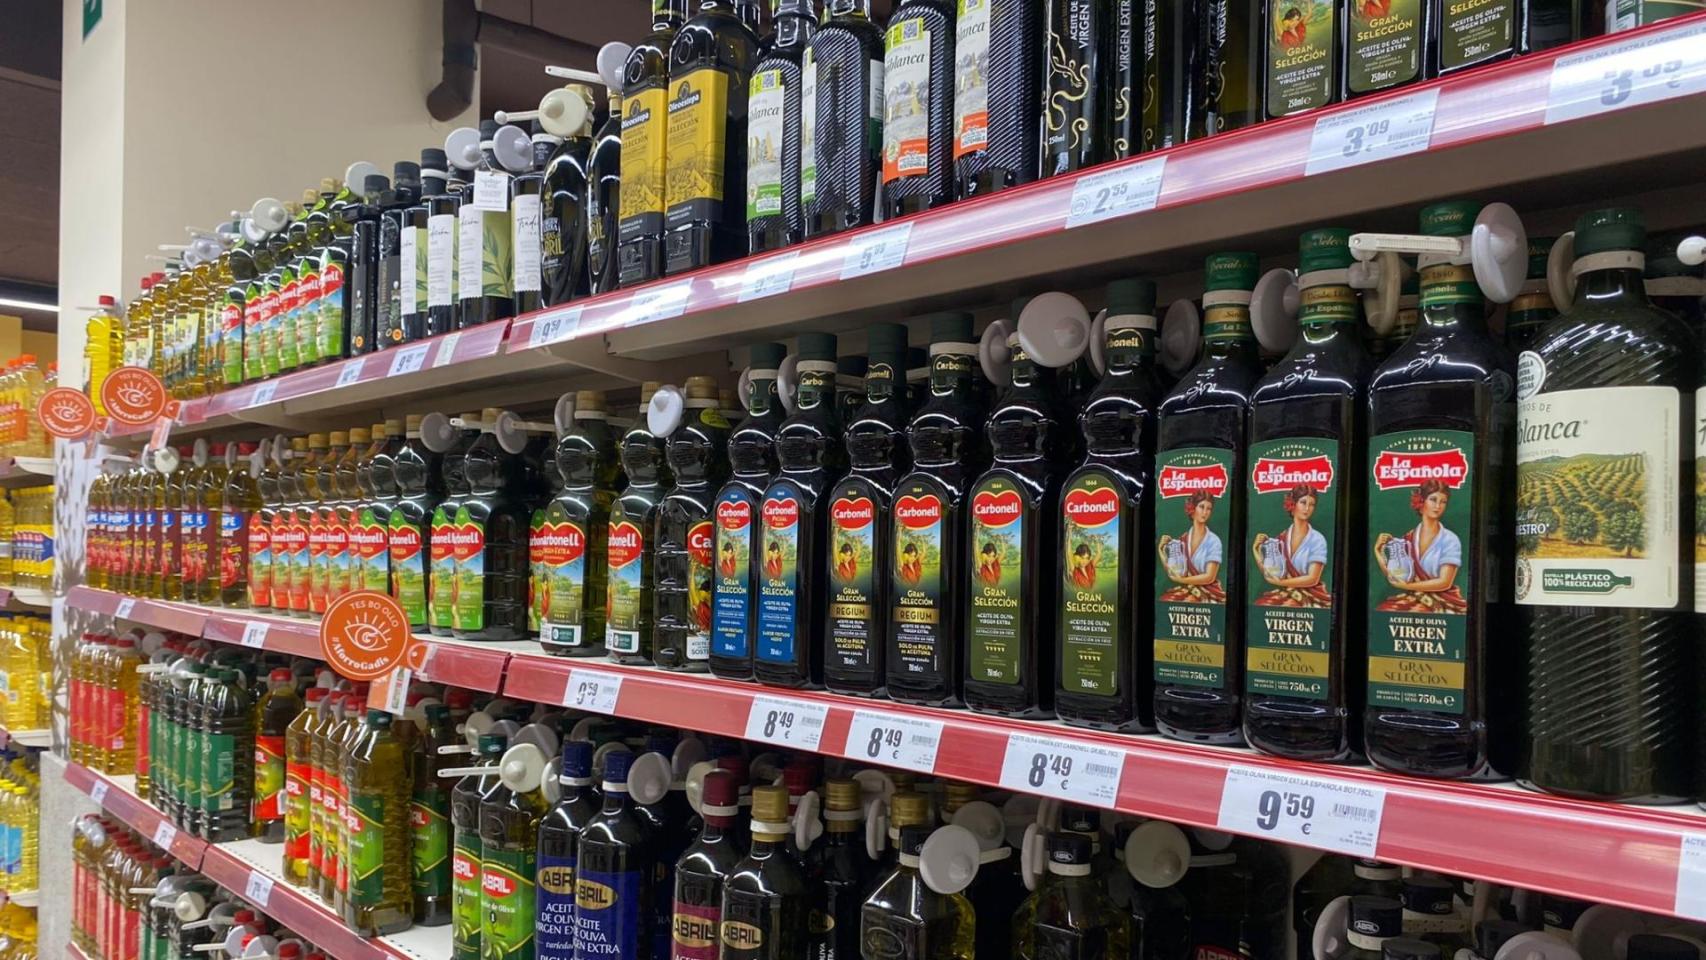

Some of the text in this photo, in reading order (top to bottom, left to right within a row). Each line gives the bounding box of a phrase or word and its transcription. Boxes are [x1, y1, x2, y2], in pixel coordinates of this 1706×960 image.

[1079, 4, 1090, 48] VIRGEN
[1370, 14, 1398, 28] GRAN
[1357, 20, 1413, 41] SELECCIÓN
[1120, 30, 1130, 72] VIRGEN
[1287, 44, 1312, 56] GRAN
[1362, 44, 1406, 58] VIRGEN EXTRA
[1276, 50, 1326, 68] SELECCIÓN
[1343, 120, 1390, 157] 3'09
[1539, 404, 1552, 412] DE
[1268, 464, 1284, 474] La
[1392, 458, 1411, 468] La
[1172, 470, 1186, 480] La
[1380, 464, 1464, 480] Española
[1163, 476, 1223, 490] Española
[1258, 471, 1328, 486] Española
[719, 508, 748, 516] Carbonell
[764, 506, 796, 515] Carbonell
[898, 506, 938, 518] Carbonell
[974, 503, 1018, 514] Carbonell
[1066, 501, 1116, 513] Carbonell
[834, 509, 871, 518] Carbonell
[1544, 578, 1564, 587] 100%
[762, 586, 794, 596] SELECCIÓN
[984, 587, 1006, 596] GRAN
[1076, 592, 1102, 602] GRAN
[900, 597, 933, 606] SELECCIÓN
[974, 596, 1018, 607] SELECCIÓN
[1066, 600, 1114, 613] SELECCIÓN
[350, 600, 399, 628] TES BO OLLO
[1168, 612, 1211, 626] VIRGEN
[1265, 618, 1314, 632] VIRGEN
[1172, 625, 1210, 638] EXTRA
[1388, 625, 1446, 640] VIRGEN
[1269, 632, 1312, 646] EXTRA
[1176, 643, 1200, 652] GRAN
[1394, 640, 1444, 655] EXTRA
[1273, 652, 1302, 662] GRAN
[1399, 660, 1432, 672] GRAN
[764, 710, 794, 738] 8'49
[868, 728, 902, 760] 8'49 €
[1028, 753, 1072, 790] 8'49 €
[1267, 774, 1288, 784] VIRGEN
[1257, 790, 1314, 835] 9'59 €
[542, 912, 551, 922] DE
[674, 918, 716, 940] ABRIL
[724, 926, 760, 944] ABRIL
[580, 931, 606, 942] OLIVA
[588, 942, 620, 954] EXTRA
